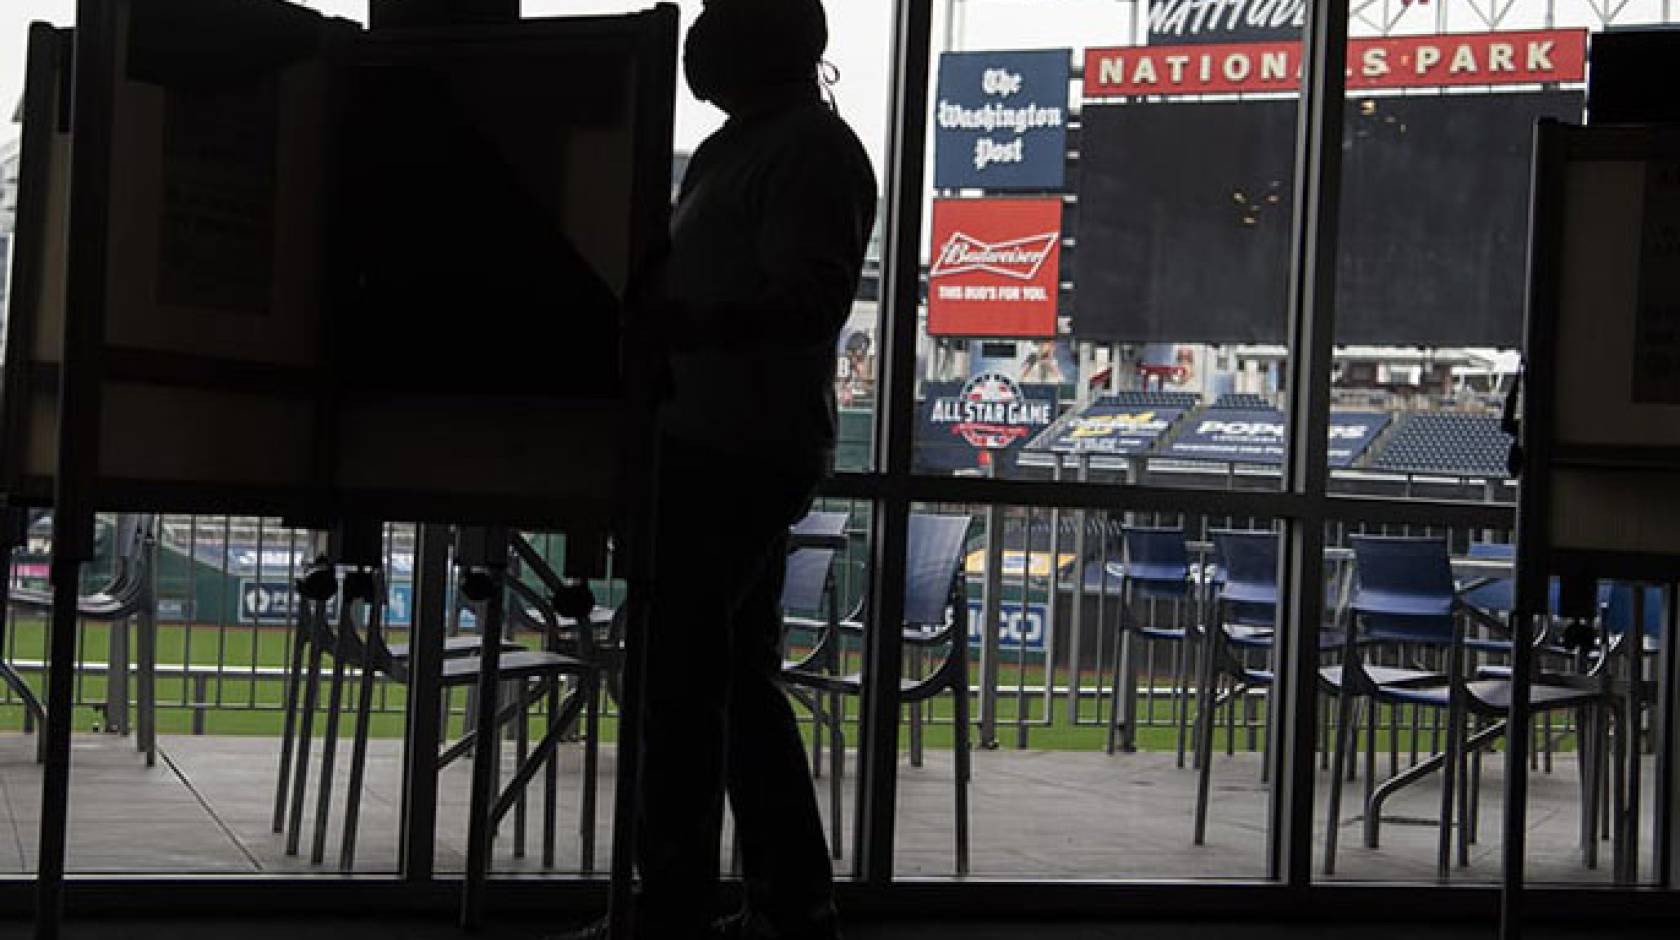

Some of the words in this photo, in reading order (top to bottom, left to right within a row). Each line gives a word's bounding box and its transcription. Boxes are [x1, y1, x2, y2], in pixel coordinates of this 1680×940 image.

[1100, 47, 1391, 84] NATIONS
[1415, 40, 1555, 75] PARK
[982, 68, 1022, 98] The
[938, 100, 1062, 133] Washington
[974, 138, 1022, 171] Post
[942, 242, 1045, 265] Budweiser
[939, 285, 962, 300] THIS
[998, 286, 1020, 300] FOR
[931, 399, 961, 421] ALL
[964, 401, 1006, 422] STAR
[1008, 402, 1051, 425] GAME
